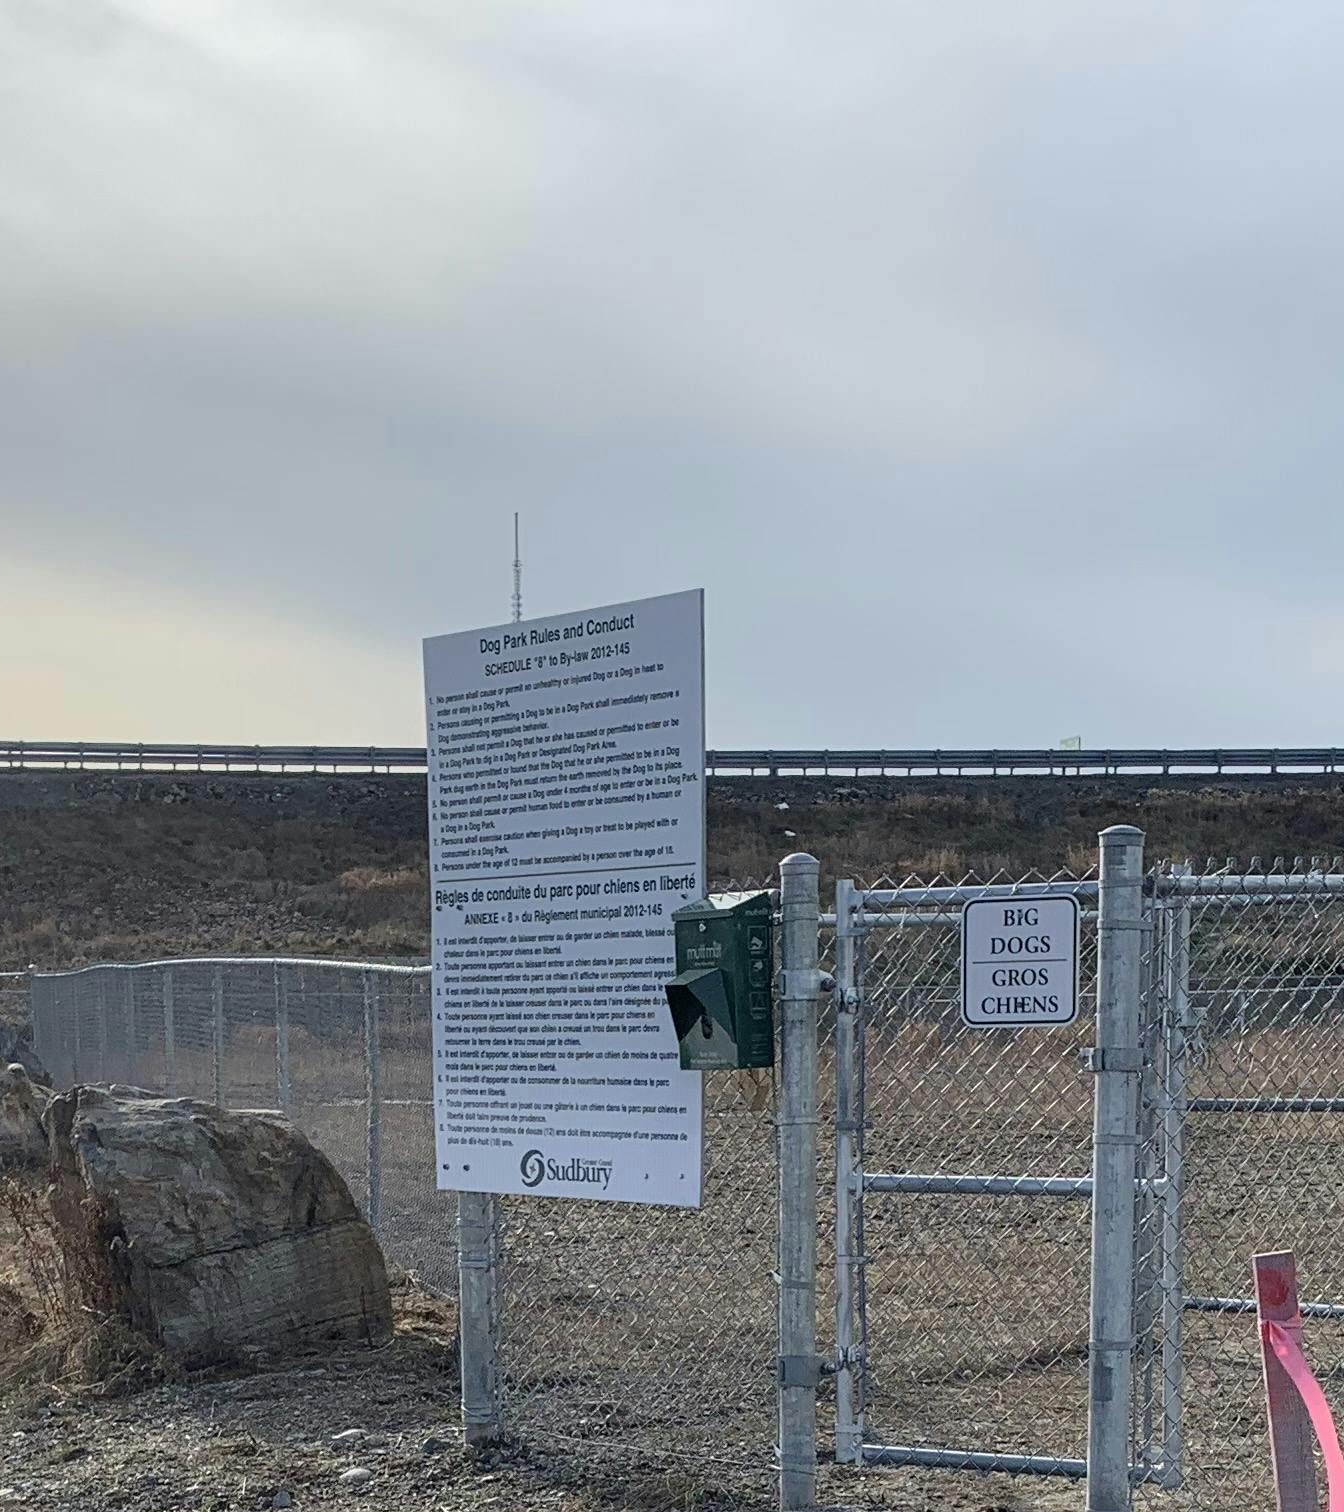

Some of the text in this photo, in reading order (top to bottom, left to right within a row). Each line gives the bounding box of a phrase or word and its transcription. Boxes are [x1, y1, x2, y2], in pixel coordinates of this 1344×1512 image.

[479, 614, 633, 656] Dog Park Rules and Conduct
[484, 657, 532, 676] SCHEDULE
[549, 653, 557, 666] to
[559, 648, 588, 667] By-law
[590, 641, 630, 660] 2012-145
[435, 873, 695, 906] Règles de conduite du parc pour chiens en liberté
[464, 912, 498, 925] ANNEXE
[507, 911, 512, 922] 8
[521, 910, 532, 922] du
[534, 908, 578, 924] Règlement
[580, 905, 621, 922] municipal
[623, 903, 663, 917] 2012-145
[1003, 908, 1038, 926] BIG
[990, 935, 1050, 954] DOGS
[992, 968, 1049, 987] GROS
[981, 995, 1058, 1014] CHIENS
[547, 1158, 612, 1191] Sudbury
